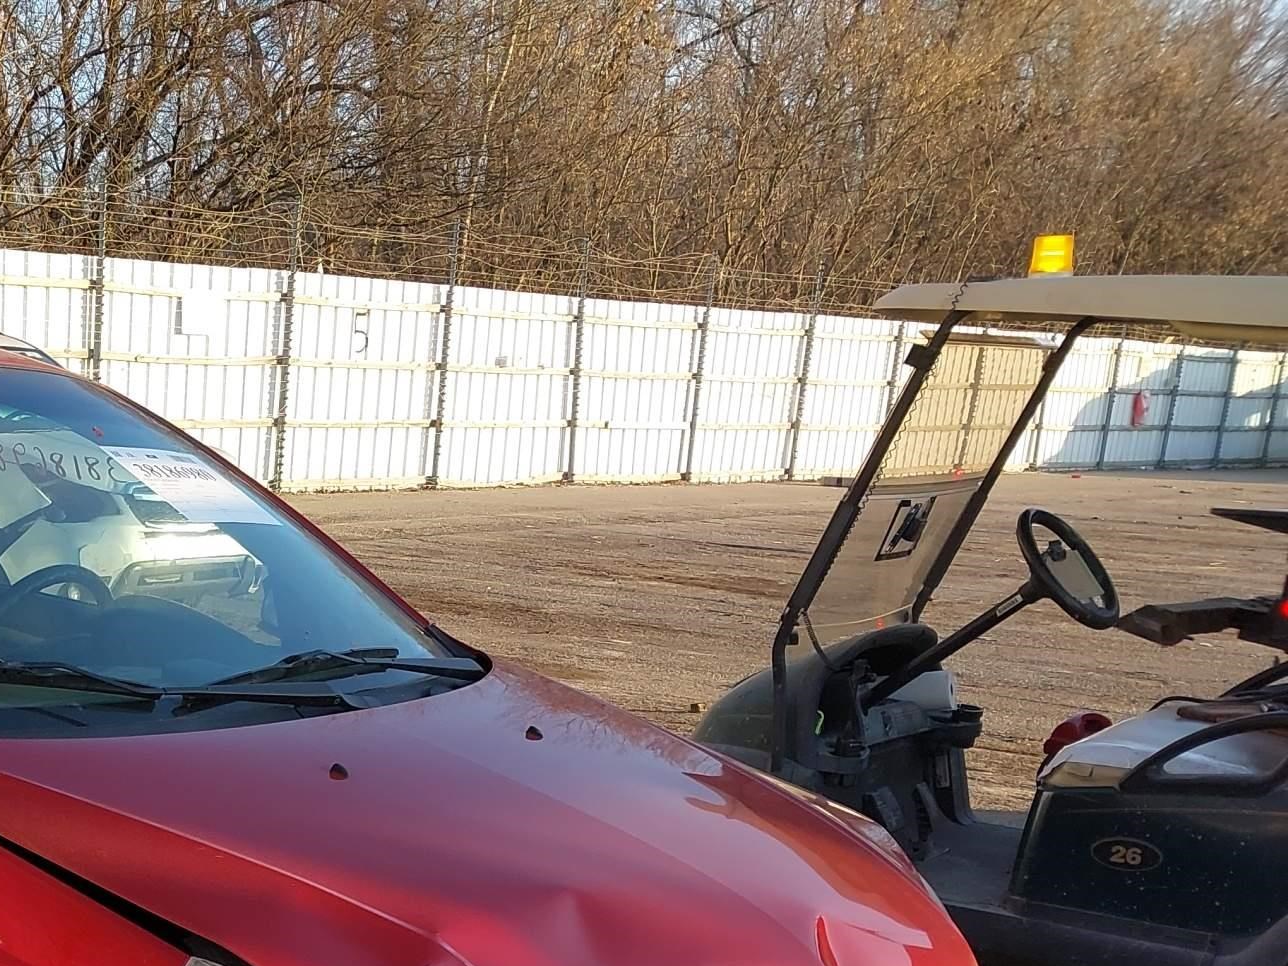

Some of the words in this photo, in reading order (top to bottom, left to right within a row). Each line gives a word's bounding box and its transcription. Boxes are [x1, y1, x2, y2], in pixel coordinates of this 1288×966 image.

[354, 308, 370, 353] 5
[132, 462, 218, 483] 38186980
[1109, 844, 1144, 866] 26
